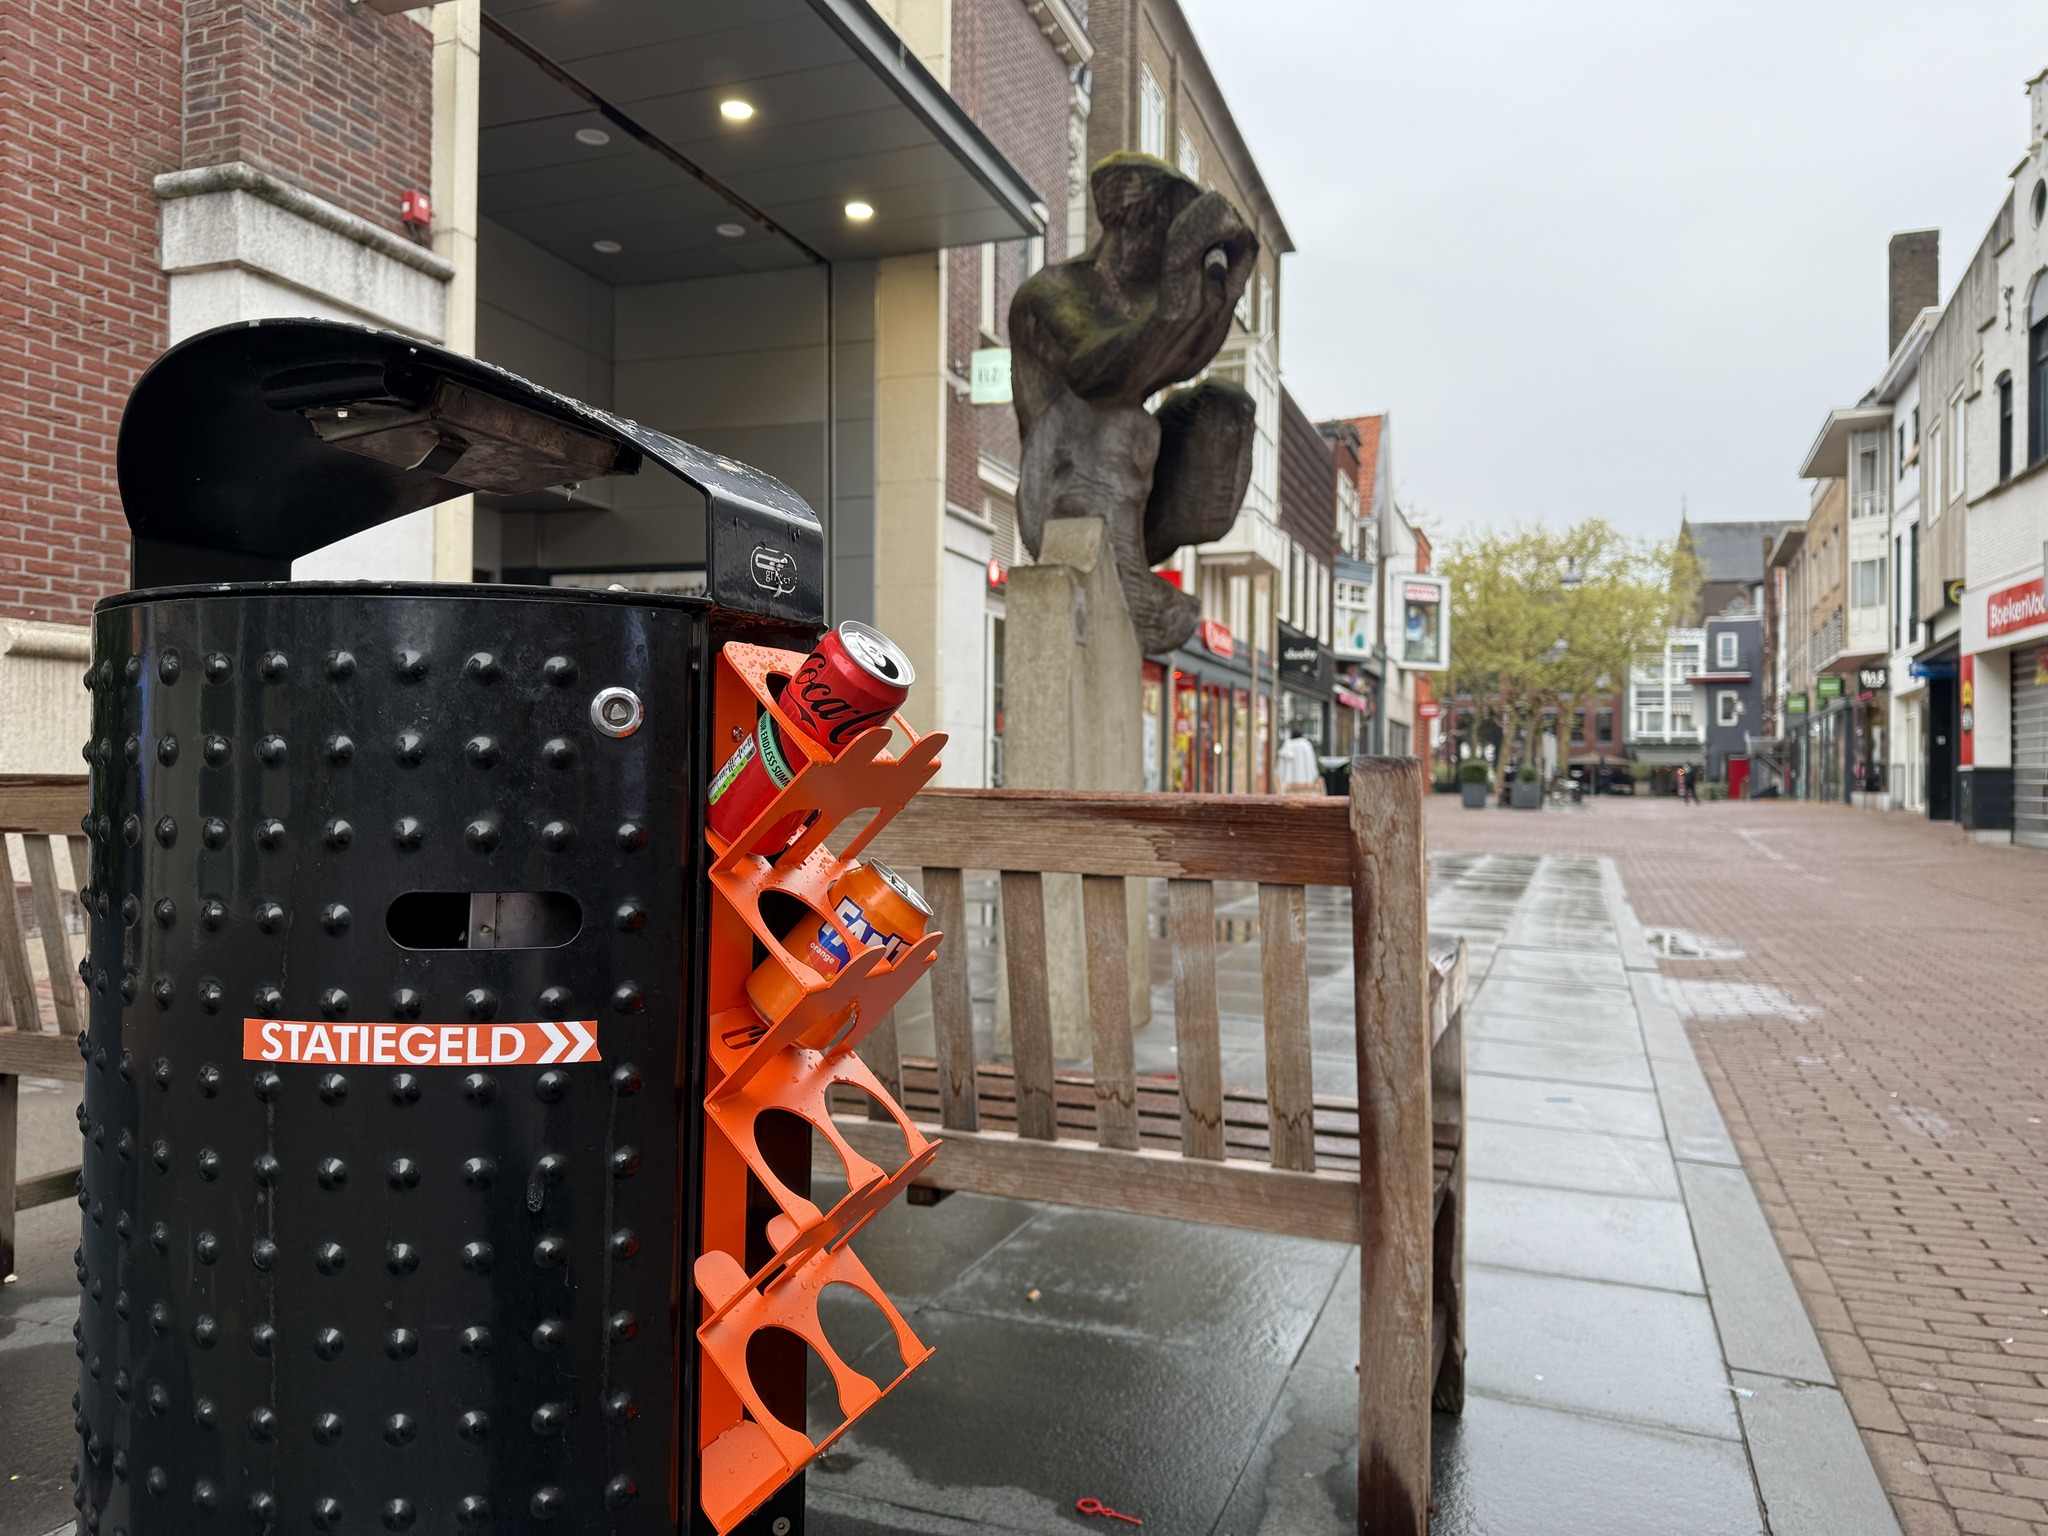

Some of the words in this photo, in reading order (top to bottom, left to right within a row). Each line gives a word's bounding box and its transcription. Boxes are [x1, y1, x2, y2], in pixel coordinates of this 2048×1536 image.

[761, 731, 778, 767] ENDLESS
[772, 766, 791, 788] SUMM
[809, 941, 836, 965] orange
[821, 898, 913, 964] FANT
[260, 1022, 526, 1064] STATIEGELD
